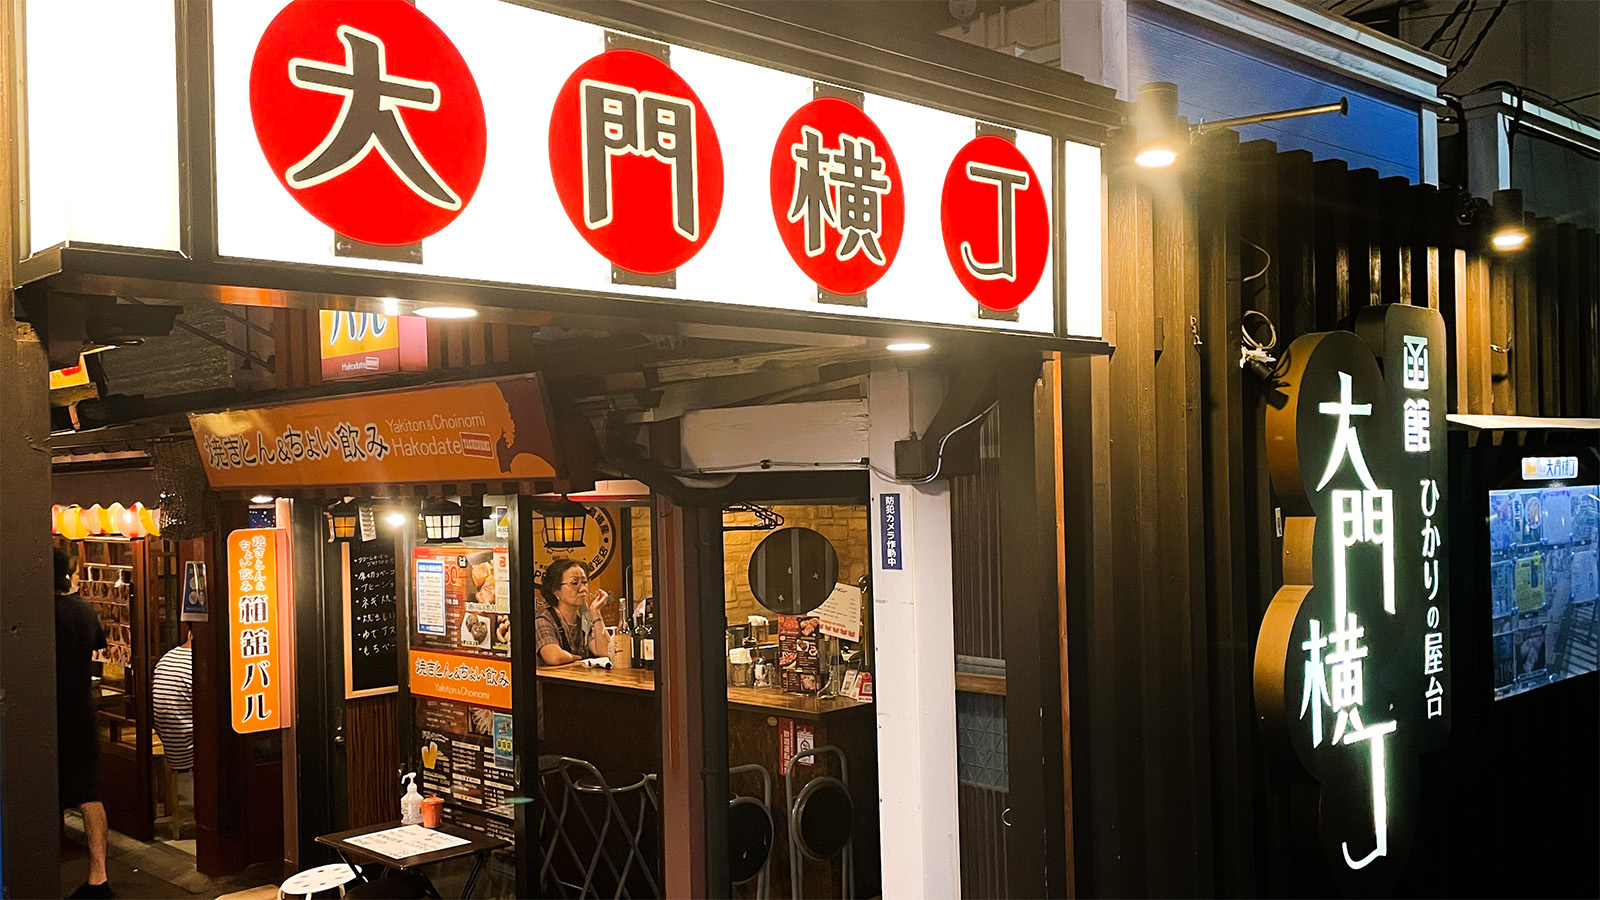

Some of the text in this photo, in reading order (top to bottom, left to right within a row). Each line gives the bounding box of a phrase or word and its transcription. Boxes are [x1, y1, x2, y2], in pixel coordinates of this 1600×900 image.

[286, 25, 1029, 283] 大門横丁
[341, 361, 366, 371] Hakodate
[204, 422, 389, 469] 焼きとん&ちょい飲み
[385, 411, 486, 434] Yakiton&Choinomi
[391, 435, 462, 457] Hakodate
[885, 496, 897, 566] 防犯カメラ作動中
[1403, 334, 1443, 719] 函館 ひかりの屋台
[239, 540, 254, 592] ちょい飲み
[1299, 370, 1397, 870] 大門横丁
